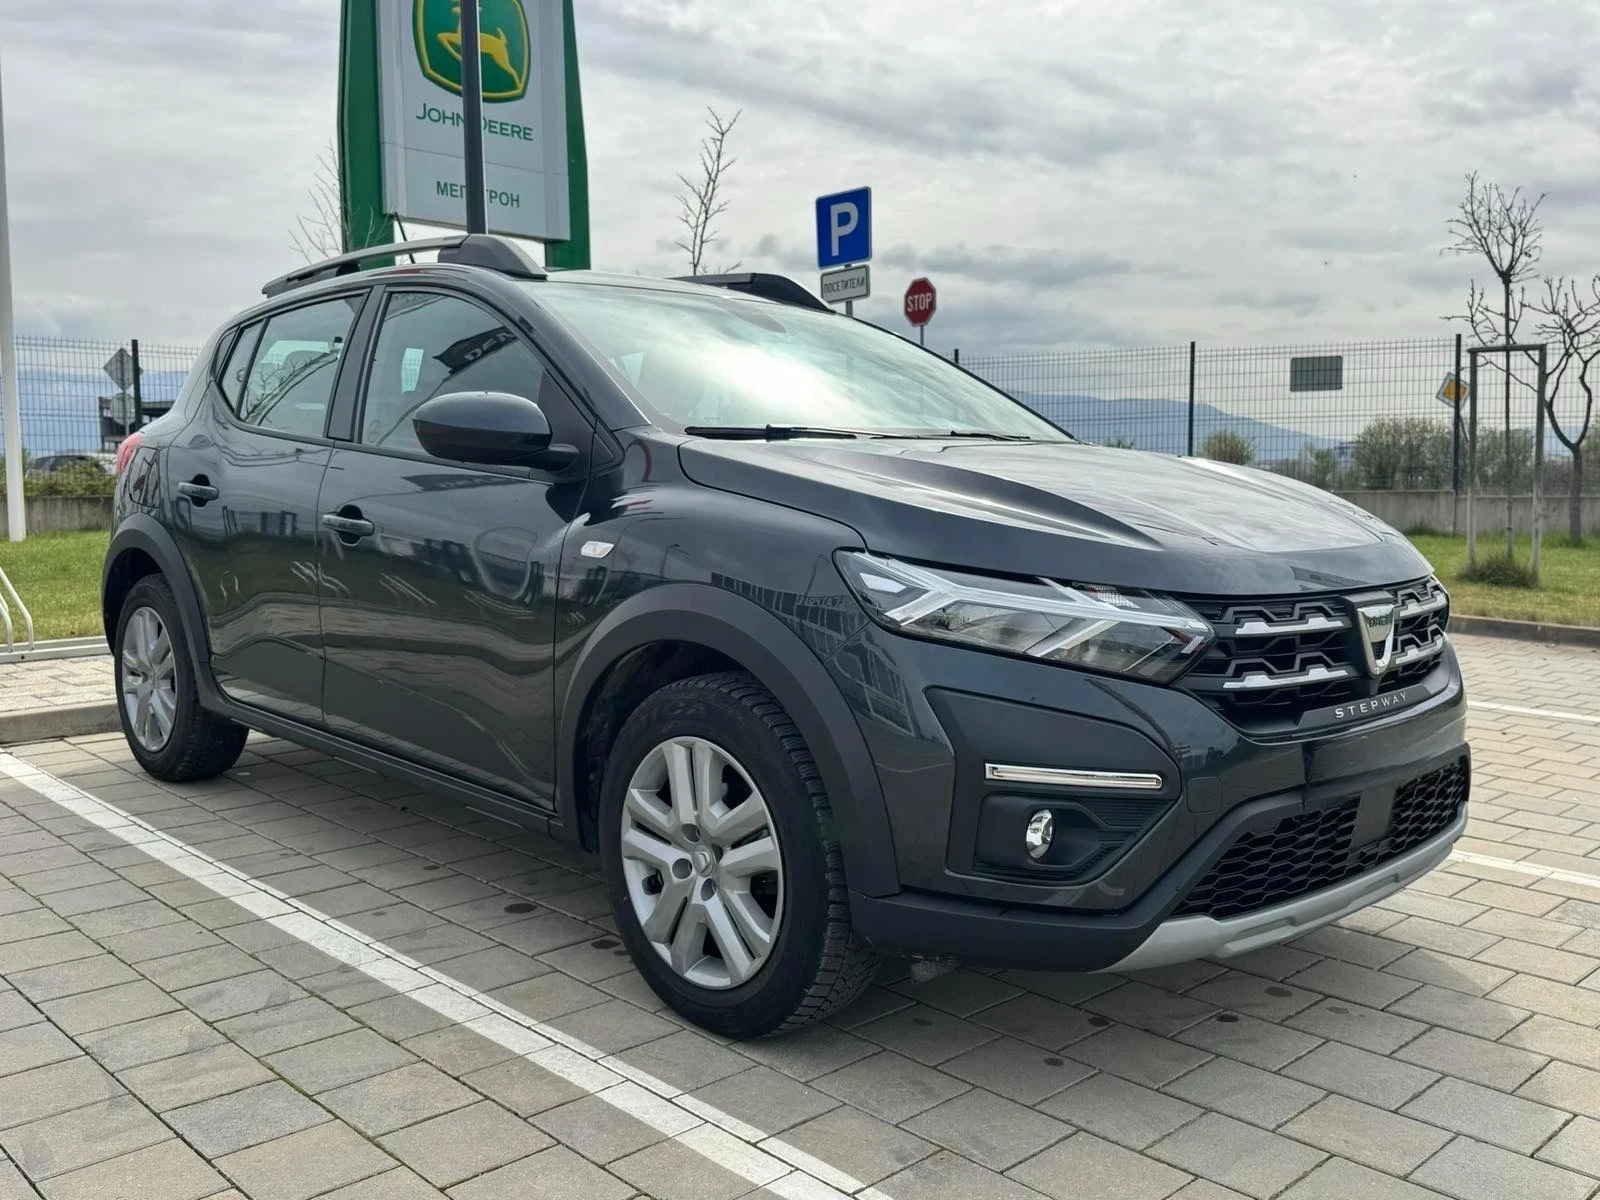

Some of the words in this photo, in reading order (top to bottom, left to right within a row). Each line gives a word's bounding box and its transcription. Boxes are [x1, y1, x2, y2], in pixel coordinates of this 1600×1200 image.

[436, 181, 520, 208] МЕГРОН
[830, 202, 859, 257] P
[824, 276, 865, 293] ПОСЕТИТЕЛИ
[907, 292, 932, 312] STOP
[1335, 692, 1407, 718] STEPWAY
